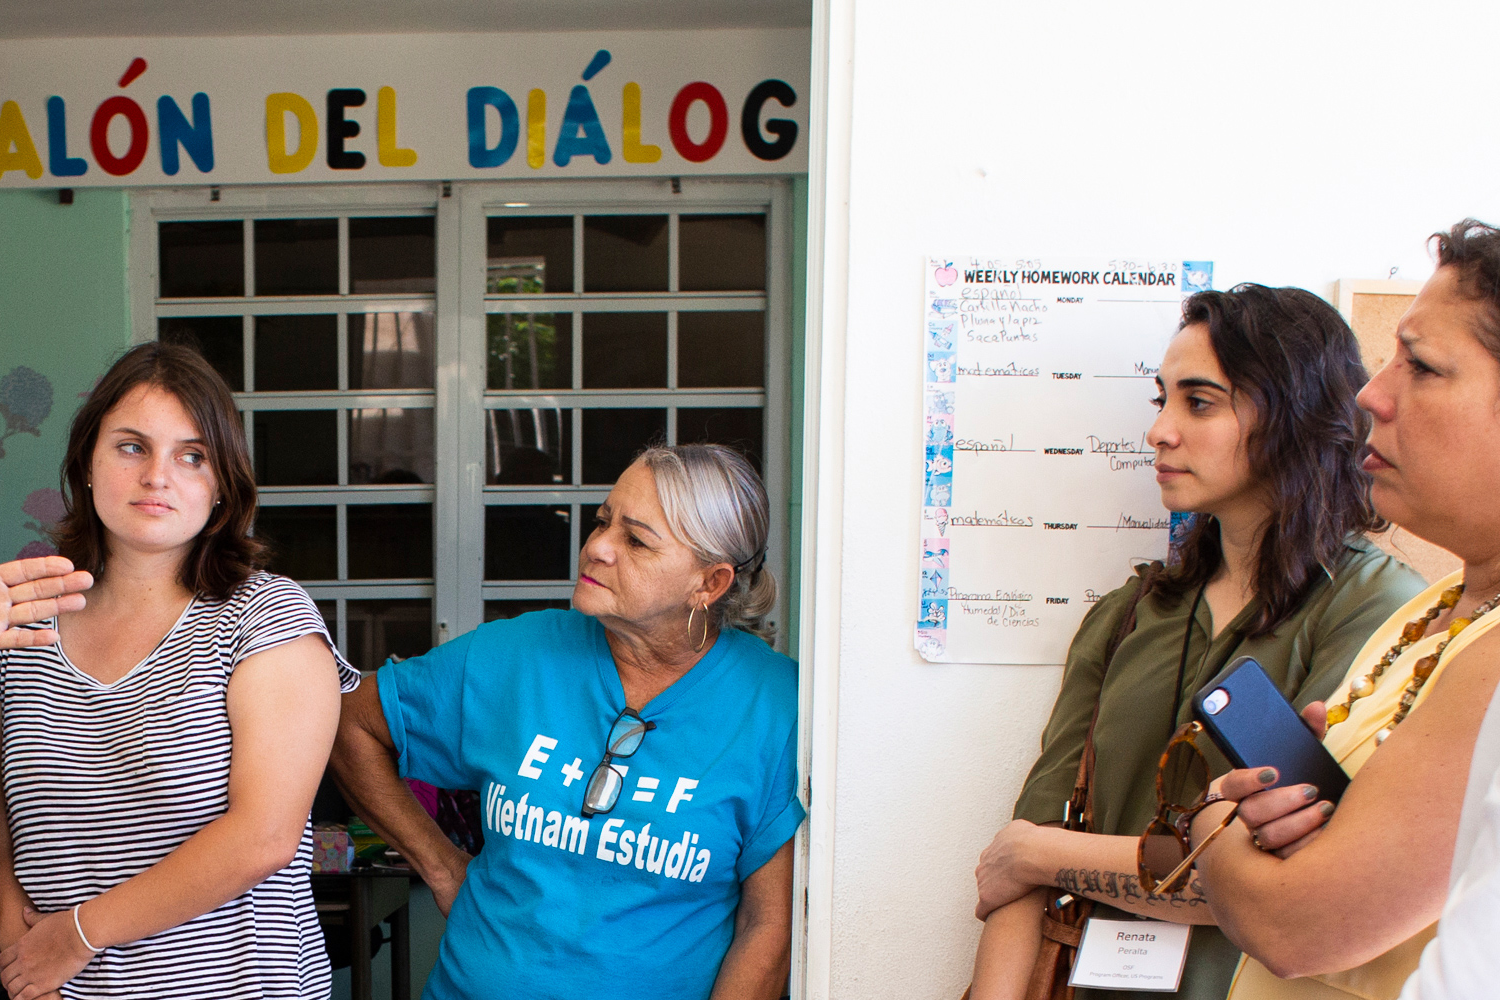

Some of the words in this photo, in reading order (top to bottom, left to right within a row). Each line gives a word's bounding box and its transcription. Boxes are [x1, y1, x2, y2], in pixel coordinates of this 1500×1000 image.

[264, 84, 418, 175] DEL
[465, 49, 800, 169] DIÁLOG
[964, 269, 1018, 283] WEEKLY
[1021, 269, 1099, 285] HOMEWORK
[1103, 271, 1176, 286] CALENDAR
[961, 283, 1022, 306] español
[955, 433, 1014, 457] español
[1043, 522, 1078, 530] THURSDAY
[986, 615, 999, 627] de
[517, 734, 558, 780] E
[665, 777, 699, 813] F
[485, 781, 590, 855] Vietnam
[596, 818, 711, 883] Estudia
[1116, 931, 1156, 942] Renata
[1118, 946, 1148, 956] Peralta
